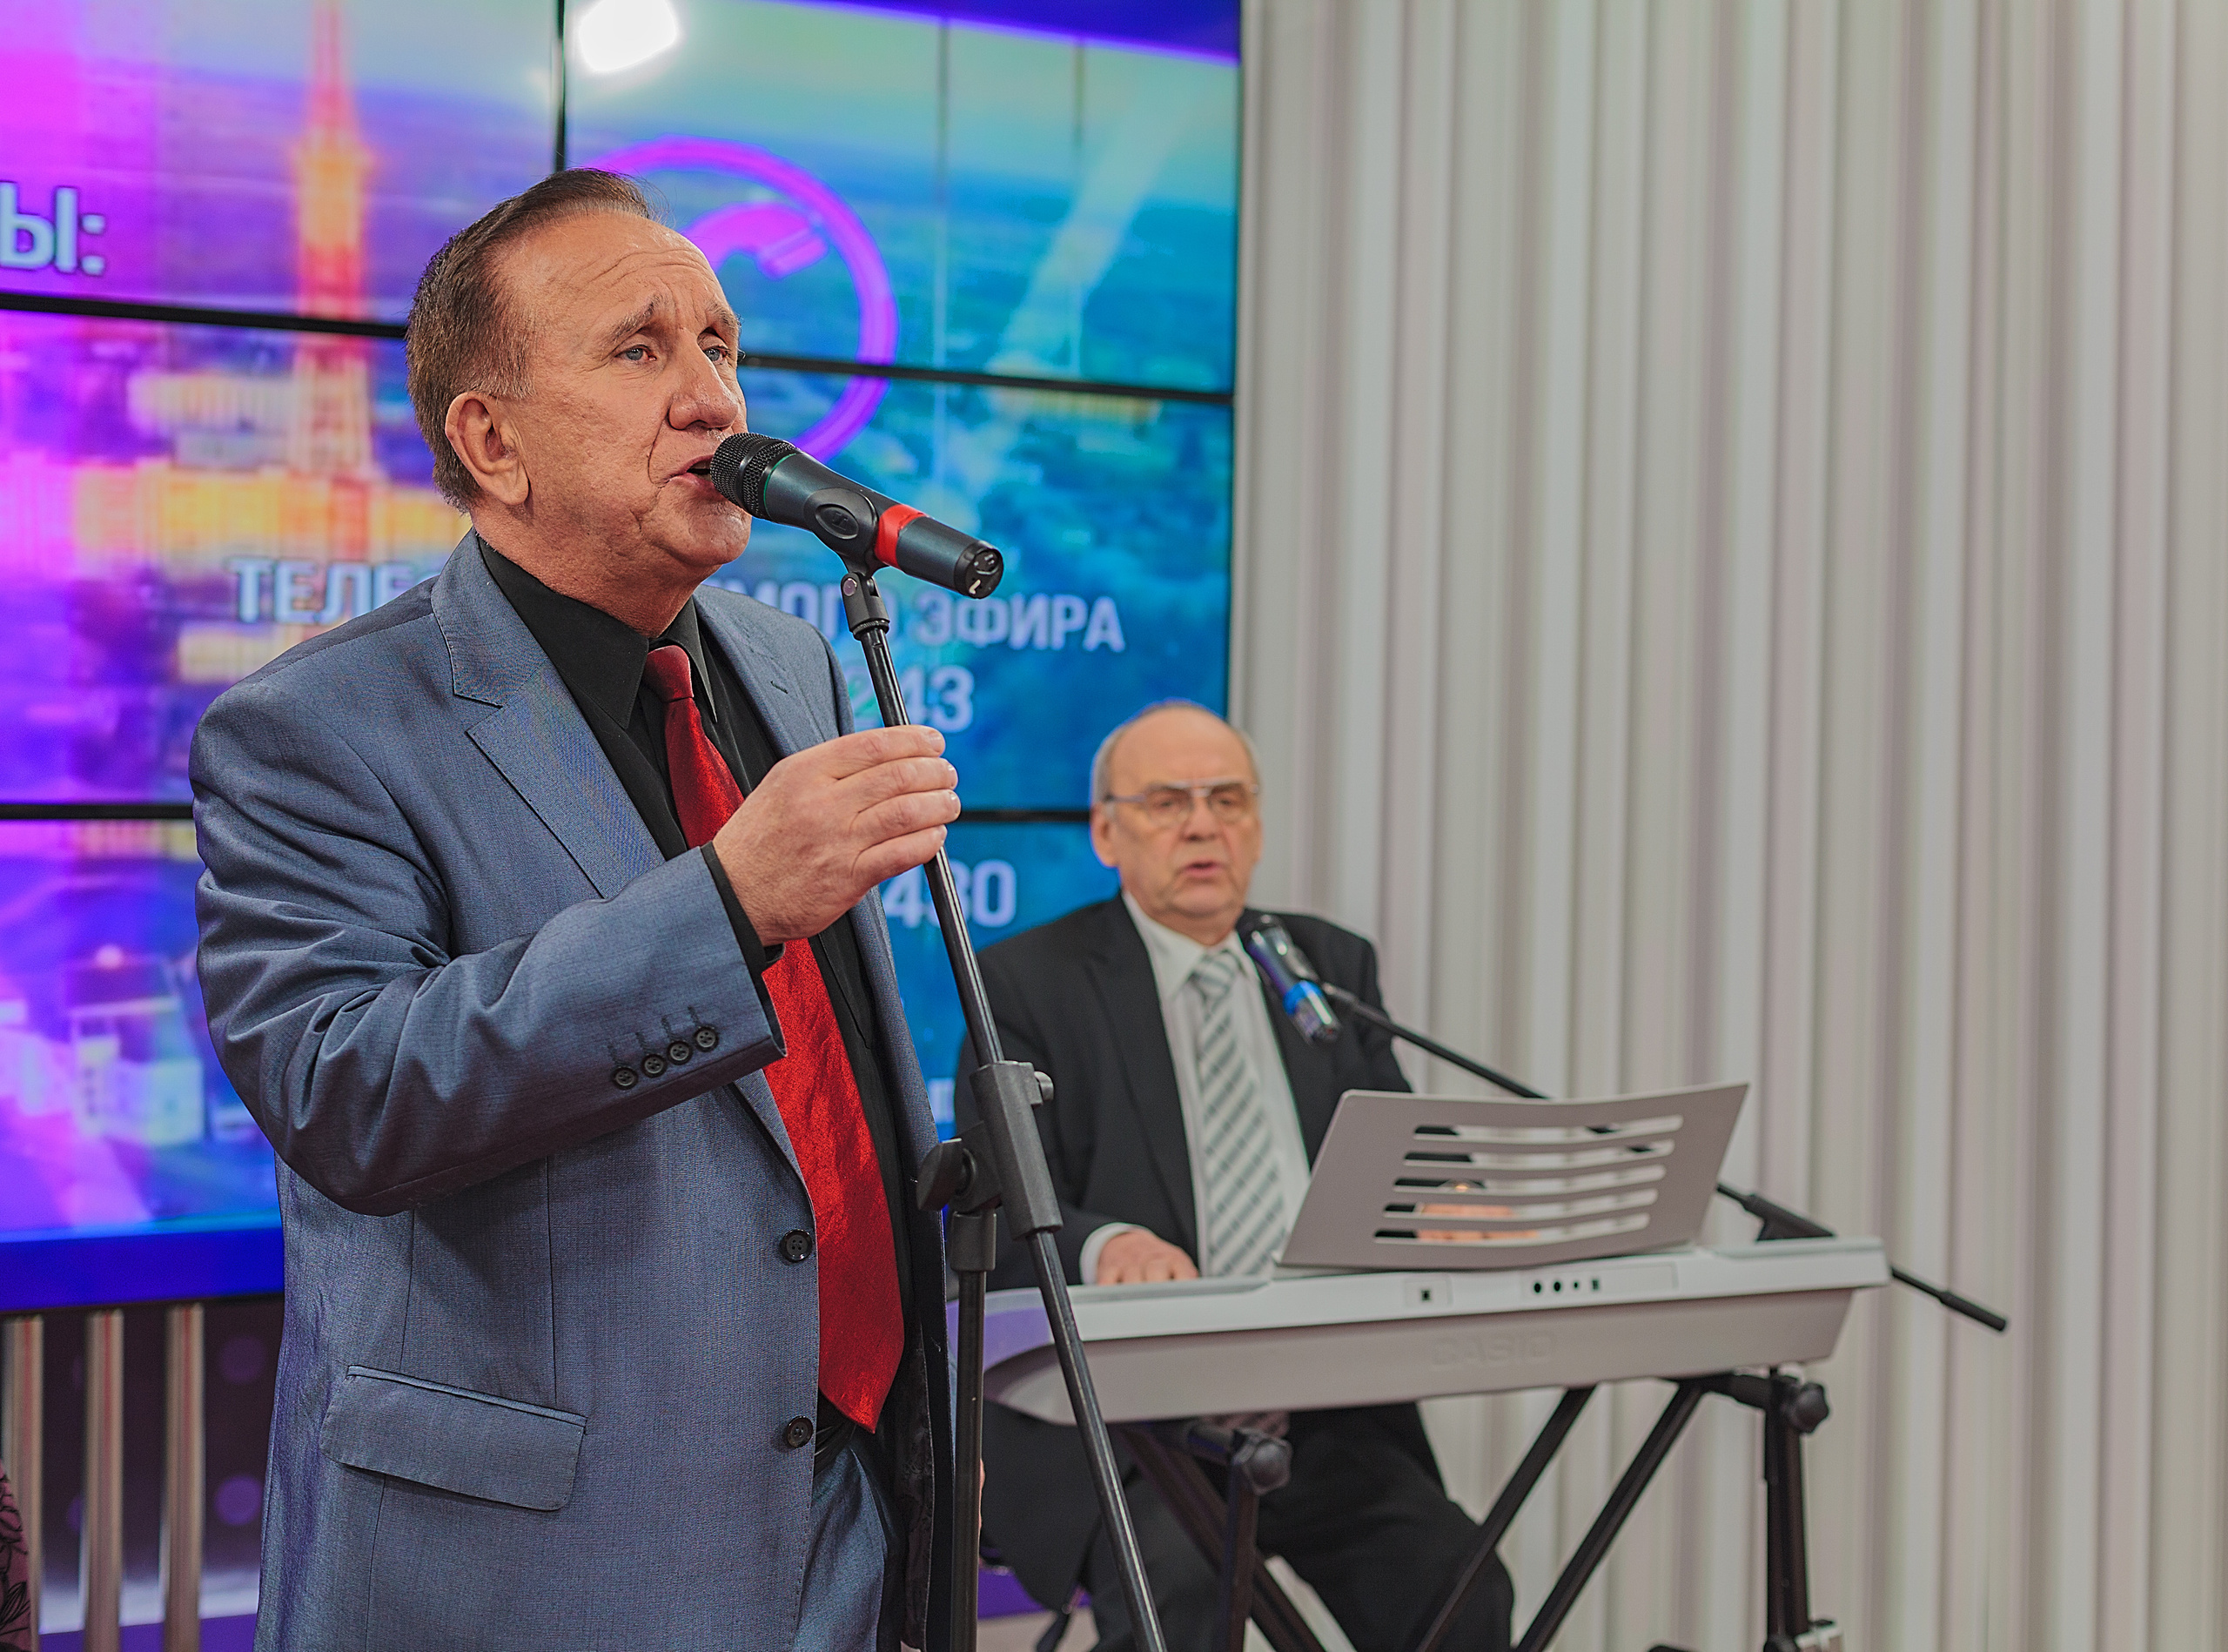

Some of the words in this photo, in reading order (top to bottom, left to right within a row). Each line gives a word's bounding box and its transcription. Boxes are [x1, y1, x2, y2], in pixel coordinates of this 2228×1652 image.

[228, 556, 440, 623] ТЕЛЕ
[915, 587, 1126, 653] ЭФИРА
[1430, 1328, 1559, 1367] CASIO
